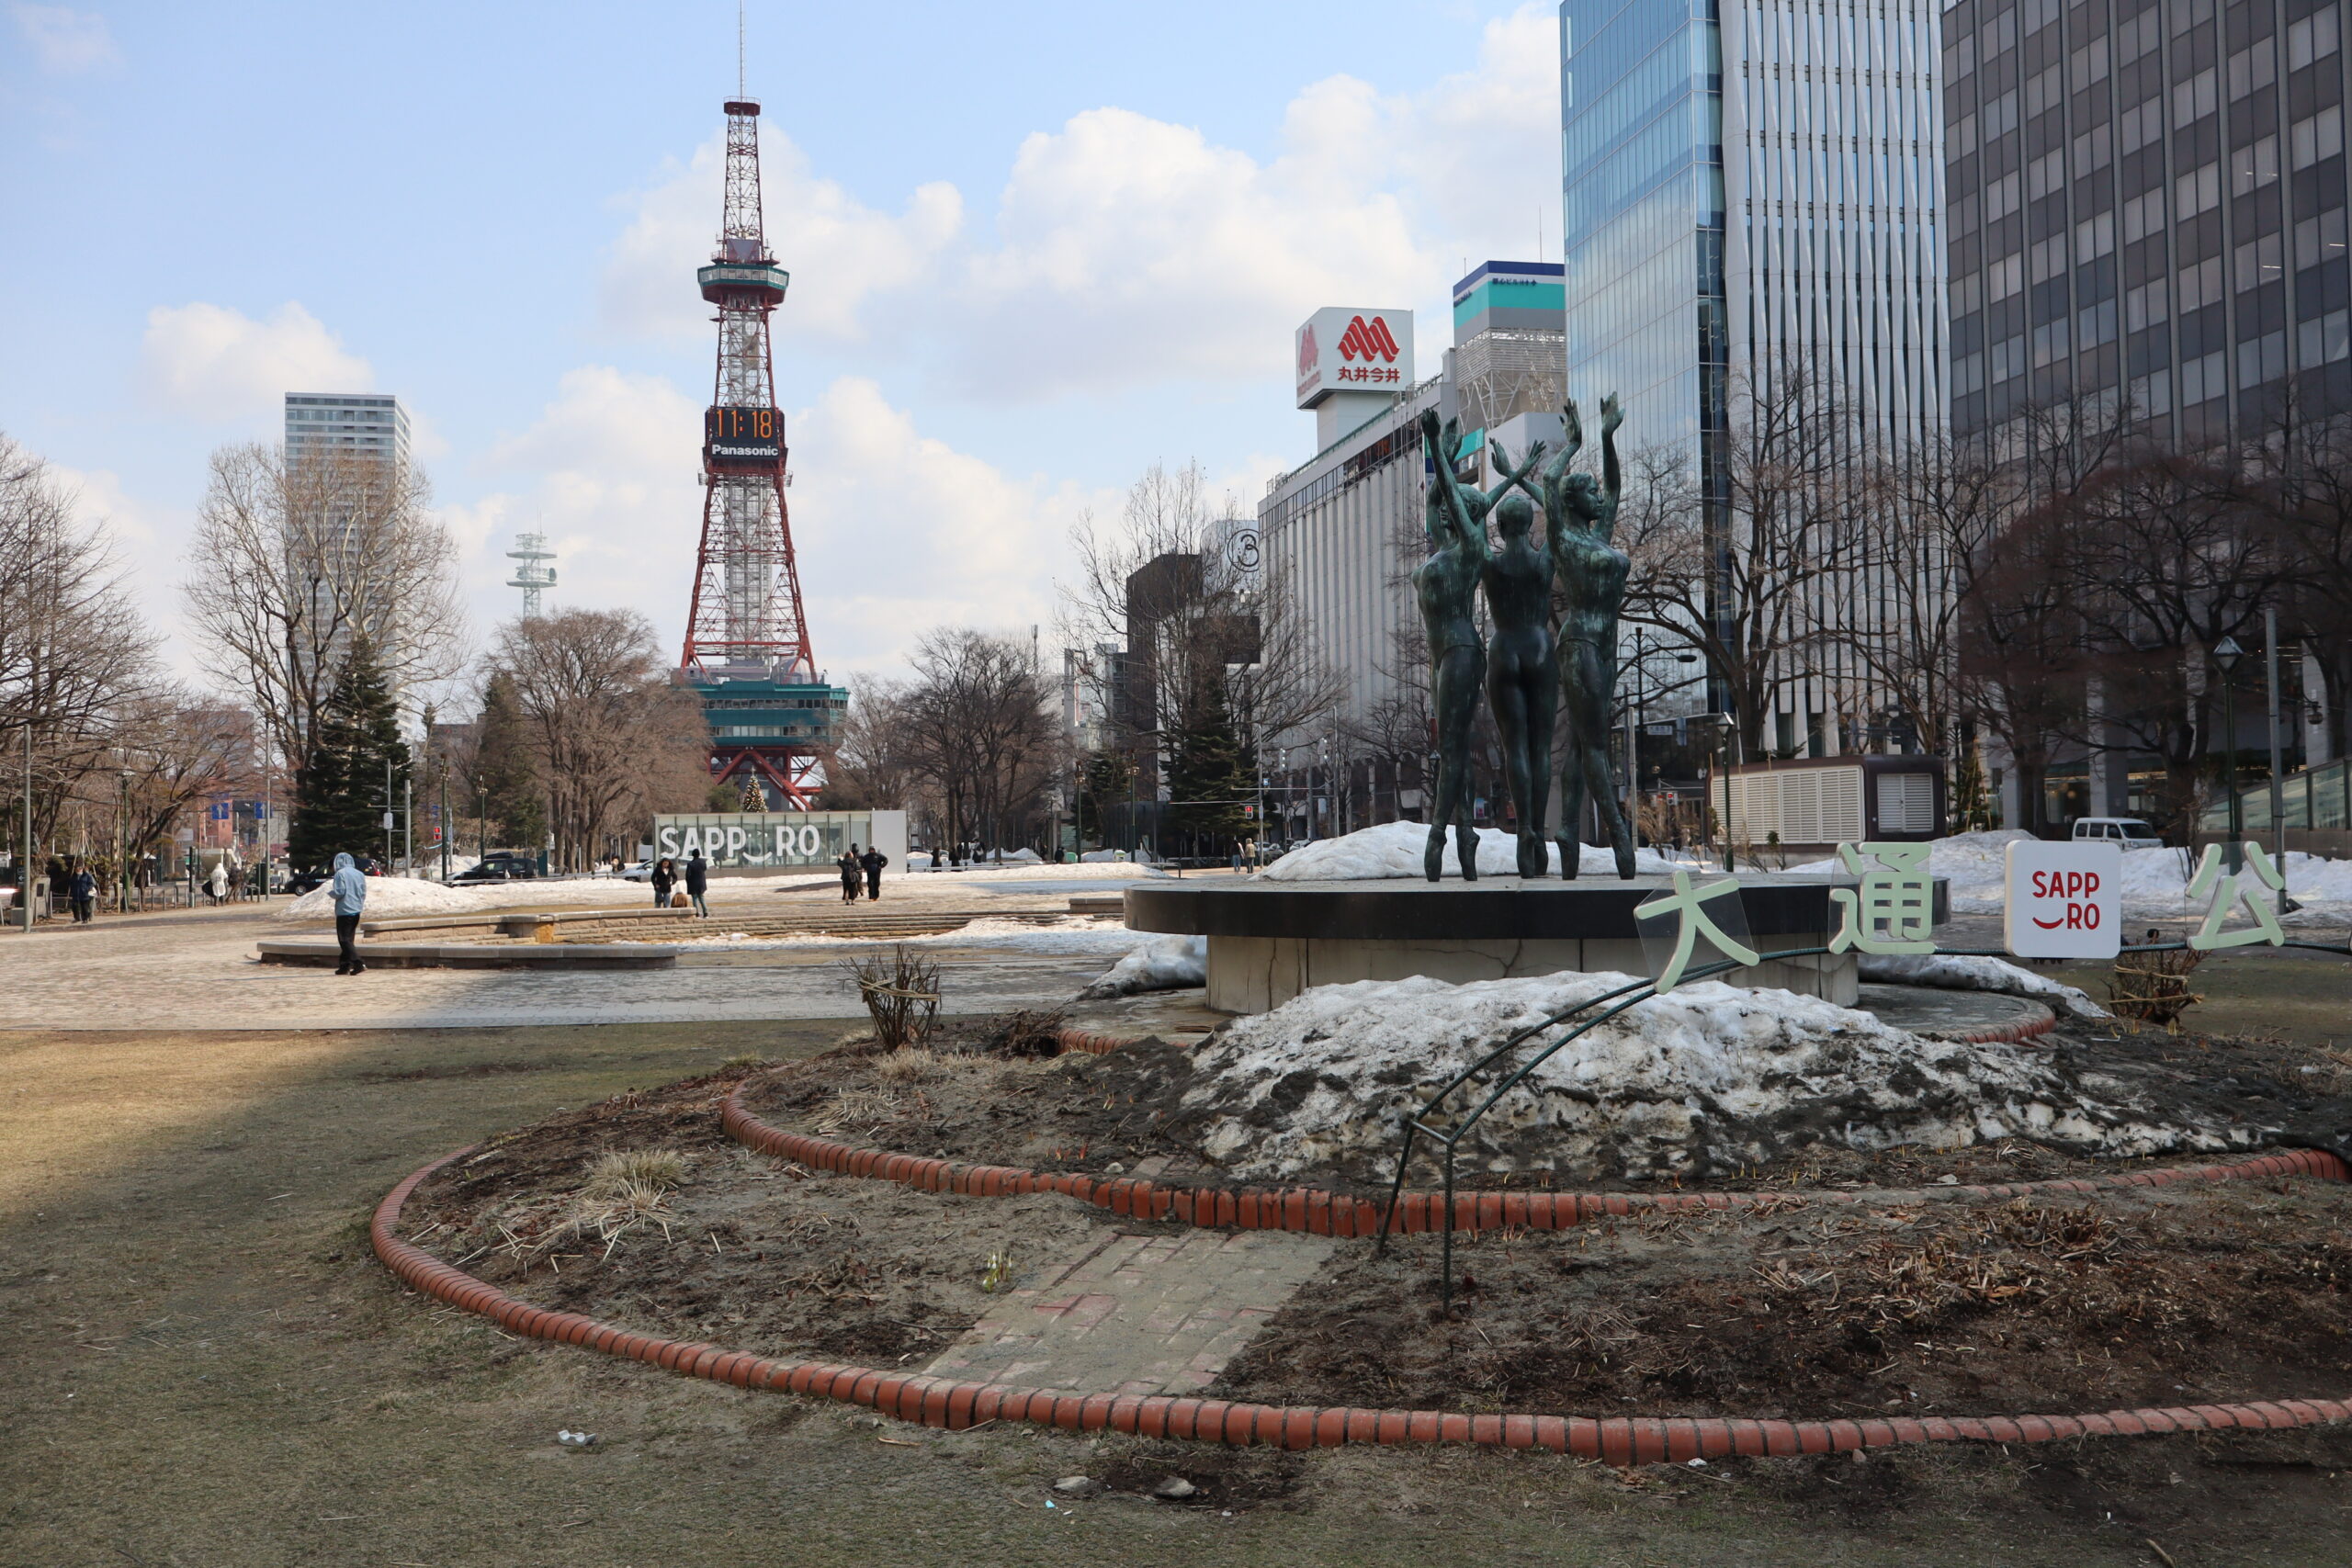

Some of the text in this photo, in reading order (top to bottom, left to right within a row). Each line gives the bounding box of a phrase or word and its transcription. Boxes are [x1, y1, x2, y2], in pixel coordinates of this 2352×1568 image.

[1338, 367, 1400, 383] 丸井今井
[717, 410, 773, 438] 11:18
[711, 445, 779, 457] Panasonic
[2032, 871, 2100, 900] SAPP
